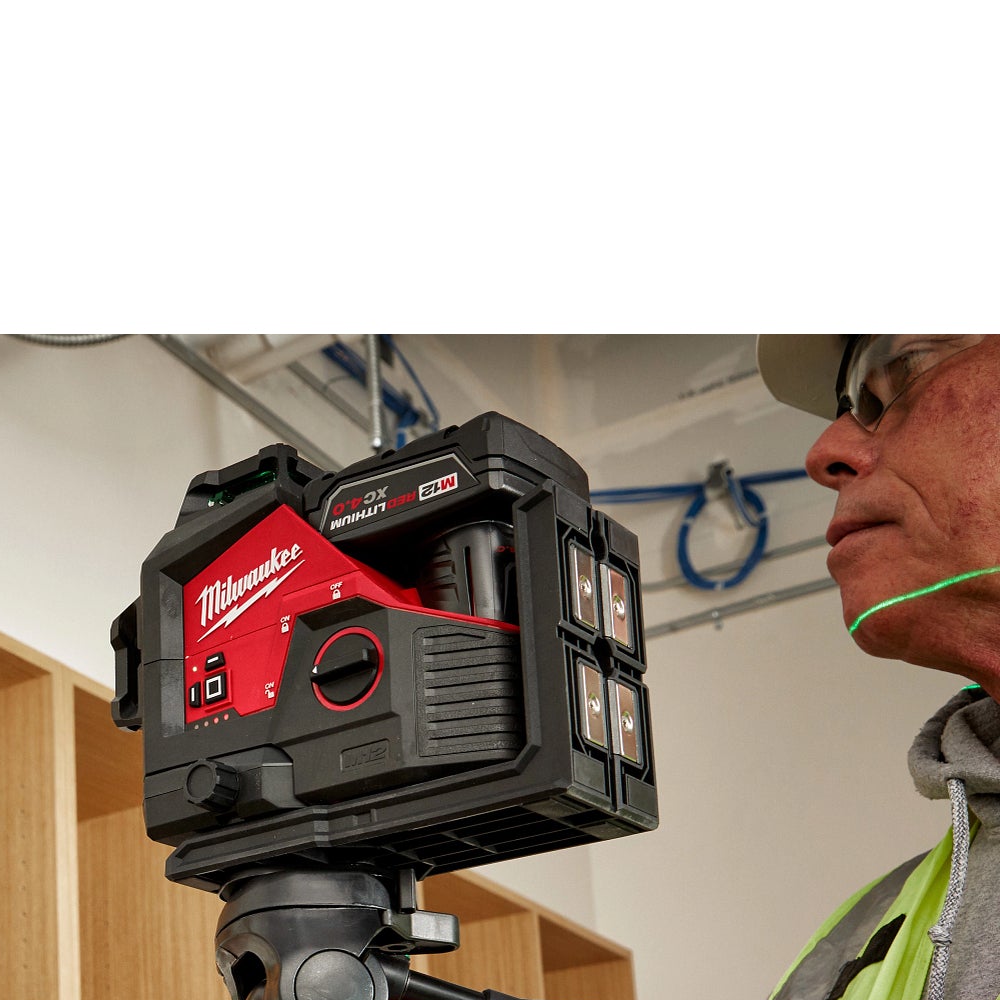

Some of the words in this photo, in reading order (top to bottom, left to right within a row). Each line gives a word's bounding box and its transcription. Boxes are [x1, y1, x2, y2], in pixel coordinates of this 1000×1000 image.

[421, 474, 456, 499] M12
[195, 543, 304, 628] Milwaukee
[329, 581, 343, 591] OFF
[280, 614, 291, 623] ON
[264, 681, 275, 690] ON
[344, 745, 387, 769] M12
